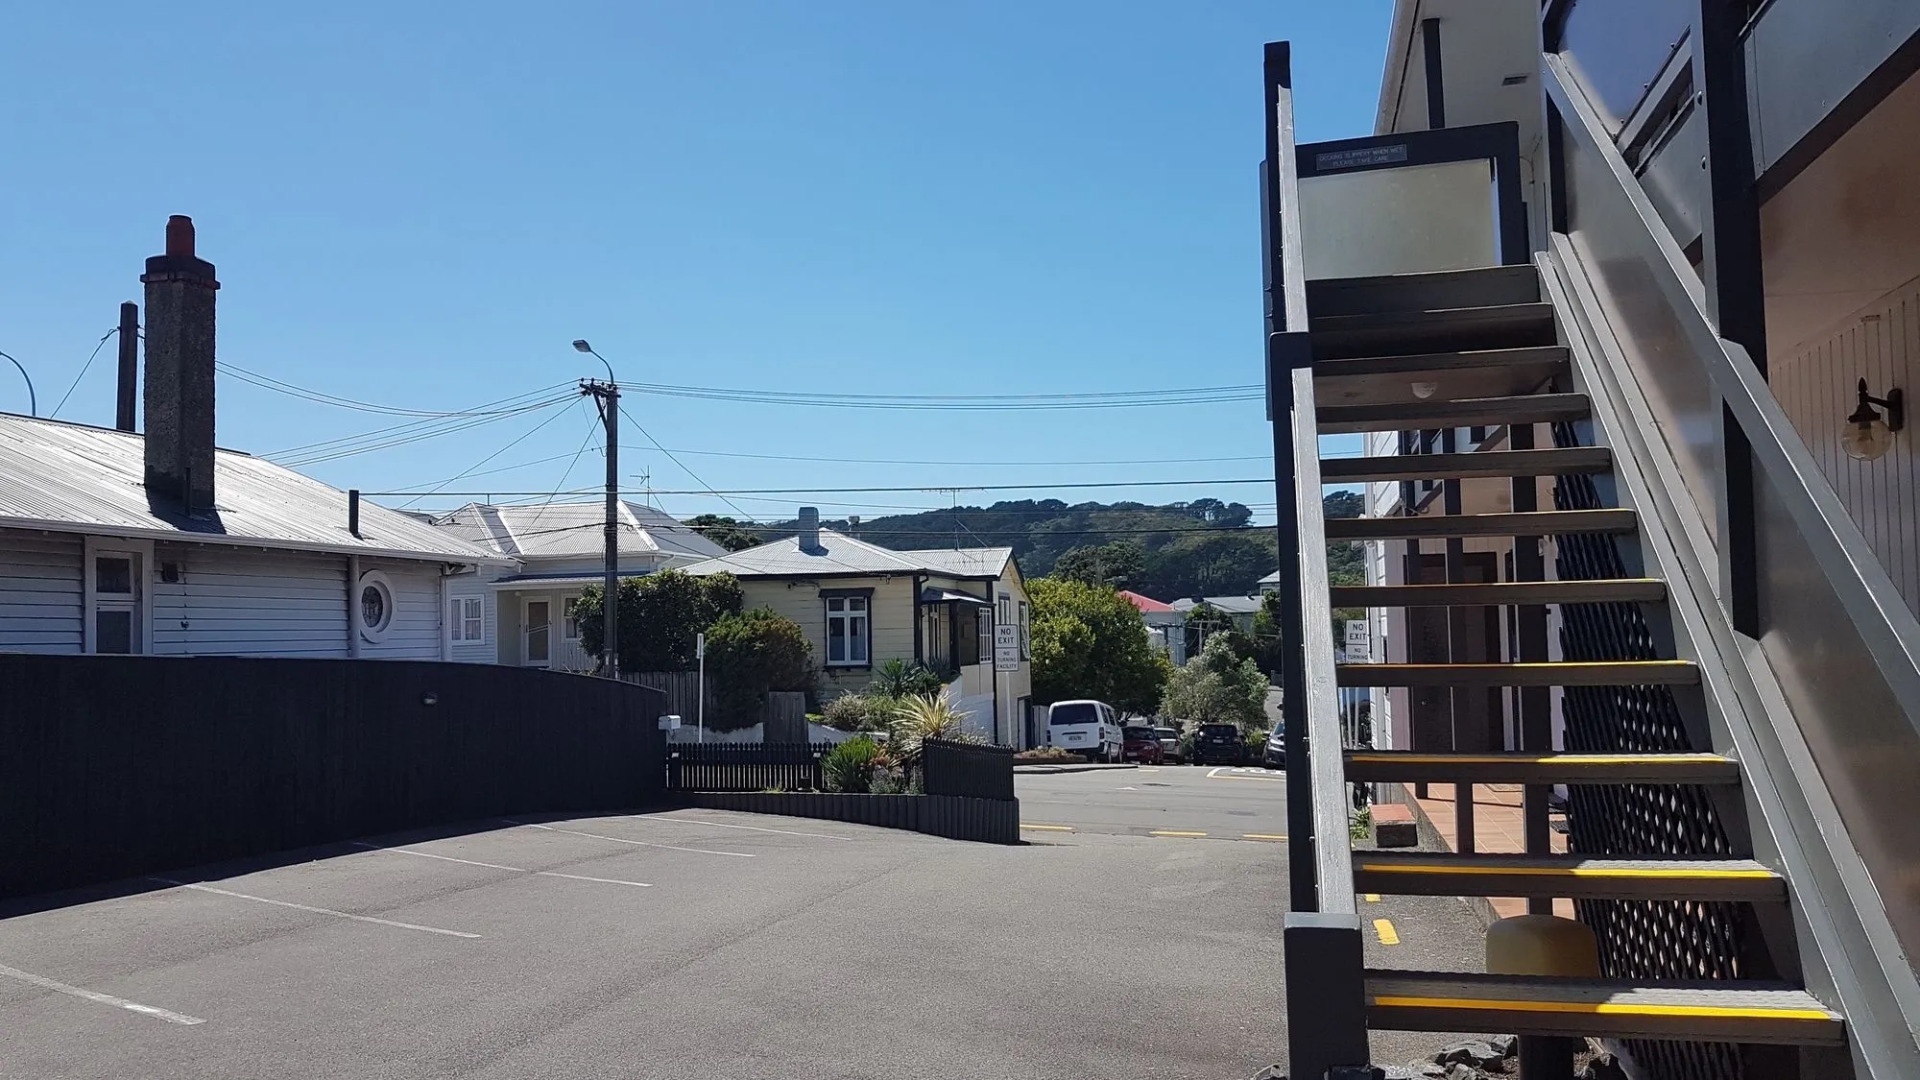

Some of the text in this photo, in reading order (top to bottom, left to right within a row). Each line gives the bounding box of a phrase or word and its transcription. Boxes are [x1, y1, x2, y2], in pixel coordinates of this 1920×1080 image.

[1372, 148, 1389, 156] WHEN
[1390, 146, 1404, 154] WET
[1332, 160, 1354, 168] PLEASE
[1353, 623, 1363, 631] NO
[1000, 628, 1011, 636] NO
